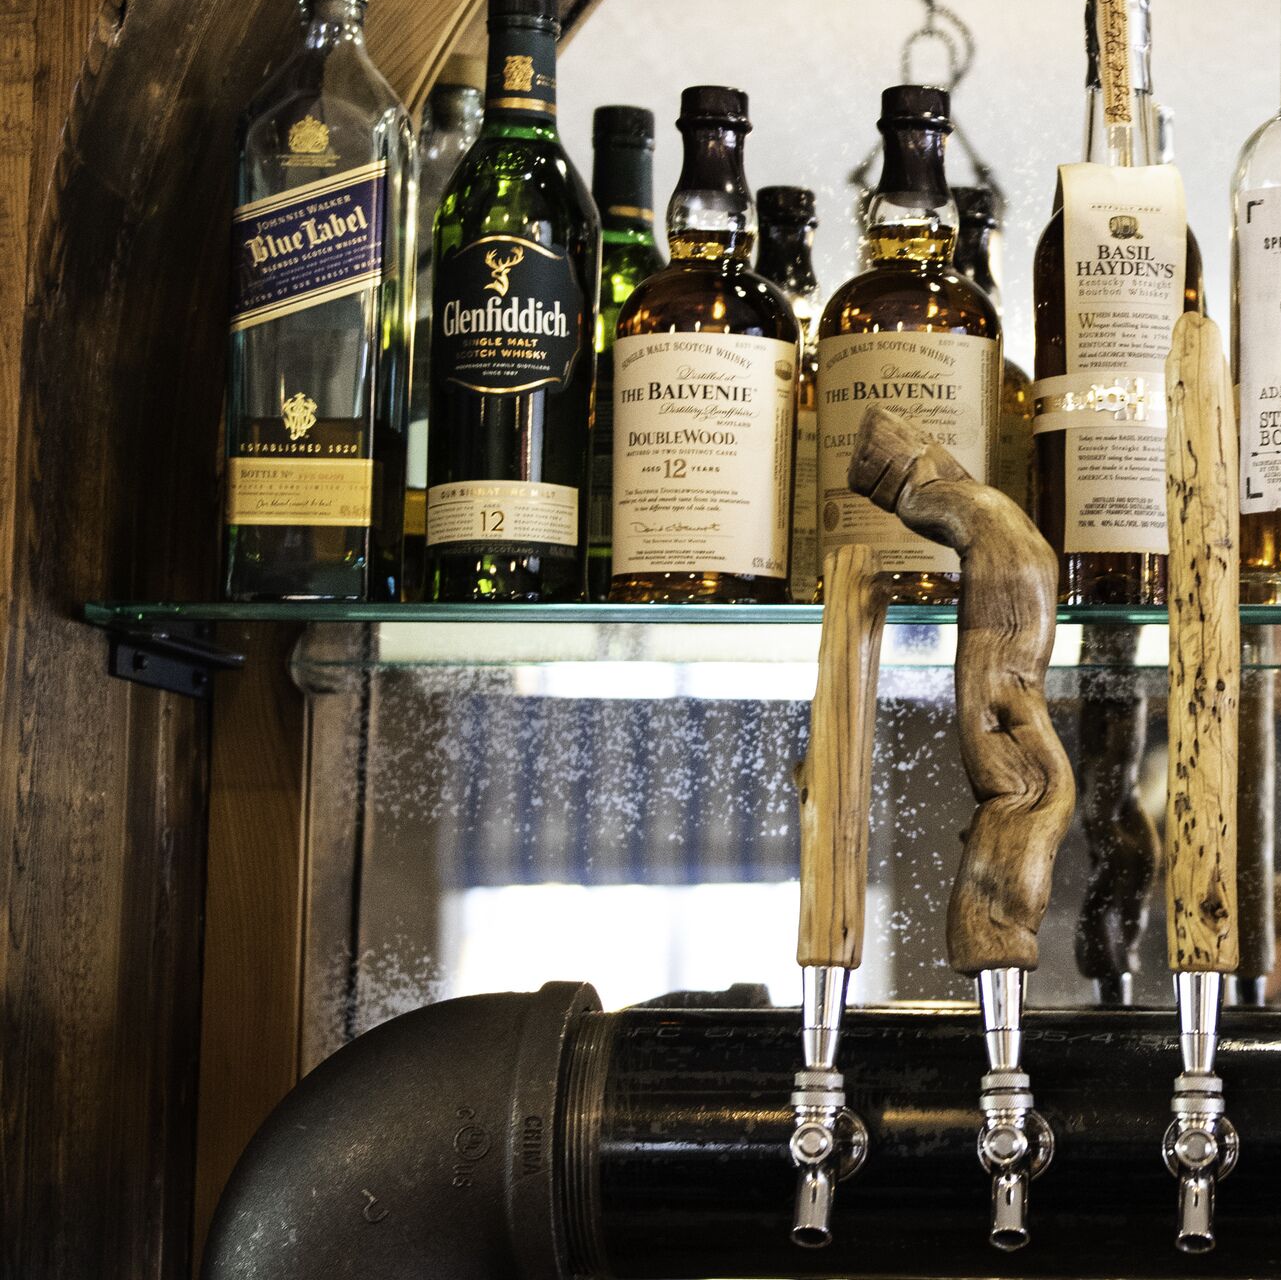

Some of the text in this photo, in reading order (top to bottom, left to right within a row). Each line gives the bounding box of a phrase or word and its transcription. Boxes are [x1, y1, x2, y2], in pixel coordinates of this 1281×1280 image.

[256, 194, 352, 234] JOHNNIE WALKER
[244, 205, 369, 267] Blue Label
[262, 234, 368, 274] BLENDED SCOTCH WHISKY
[1097, 244, 1155, 261] BASIL
[293, 280, 311, 290] OUR
[315, 267, 349, 283] RAREST
[1076, 261, 1175, 279] HAYDEN'S
[1078, 278, 1172, 289] Kentucky Straight
[1078, 287, 1169, 300] Bourbon Whiskey
[443, 295, 567, 338] Glenfiddich
[1111, 322, 1139, 330] distilling
[464, 336, 539, 348] SINGLE MALT
[456, 348, 547, 360] SCOTCH WHISKY
[621, 341, 752, 371] SINGLE MALT SCOTCH WHISKY
[826, 340, 957, 370] SINGLE MALT SCOTCH WHISKY
[517, 363, 551, 371] DISTILLERS
[676, 365, 725, 381] Distilled
[879, 363, 929, 379] Distilled
[621, 381, 752, 404] THE BALVENIE
[825, 381, 957, 404] THE BALVENIE
[716, 420, 751, 428] SCOTLAND
[921, 418, 957, 426] SCOTLAND
[628, 429, 735, 447] DOUBLEWOOD
[240, 443, 358, 454] ESTABLISHED 1820
[1111, 445, 1139, 453] Straight
[1078, 454, 1107, 462] WHISKEY
[240, 469, 277, 479] BOTTLE
[641, 458, 721, 479] AGED 12 YEARS
[480, 510, 505, 533] 12
[522, 1115, 545, 1176] CHINA
